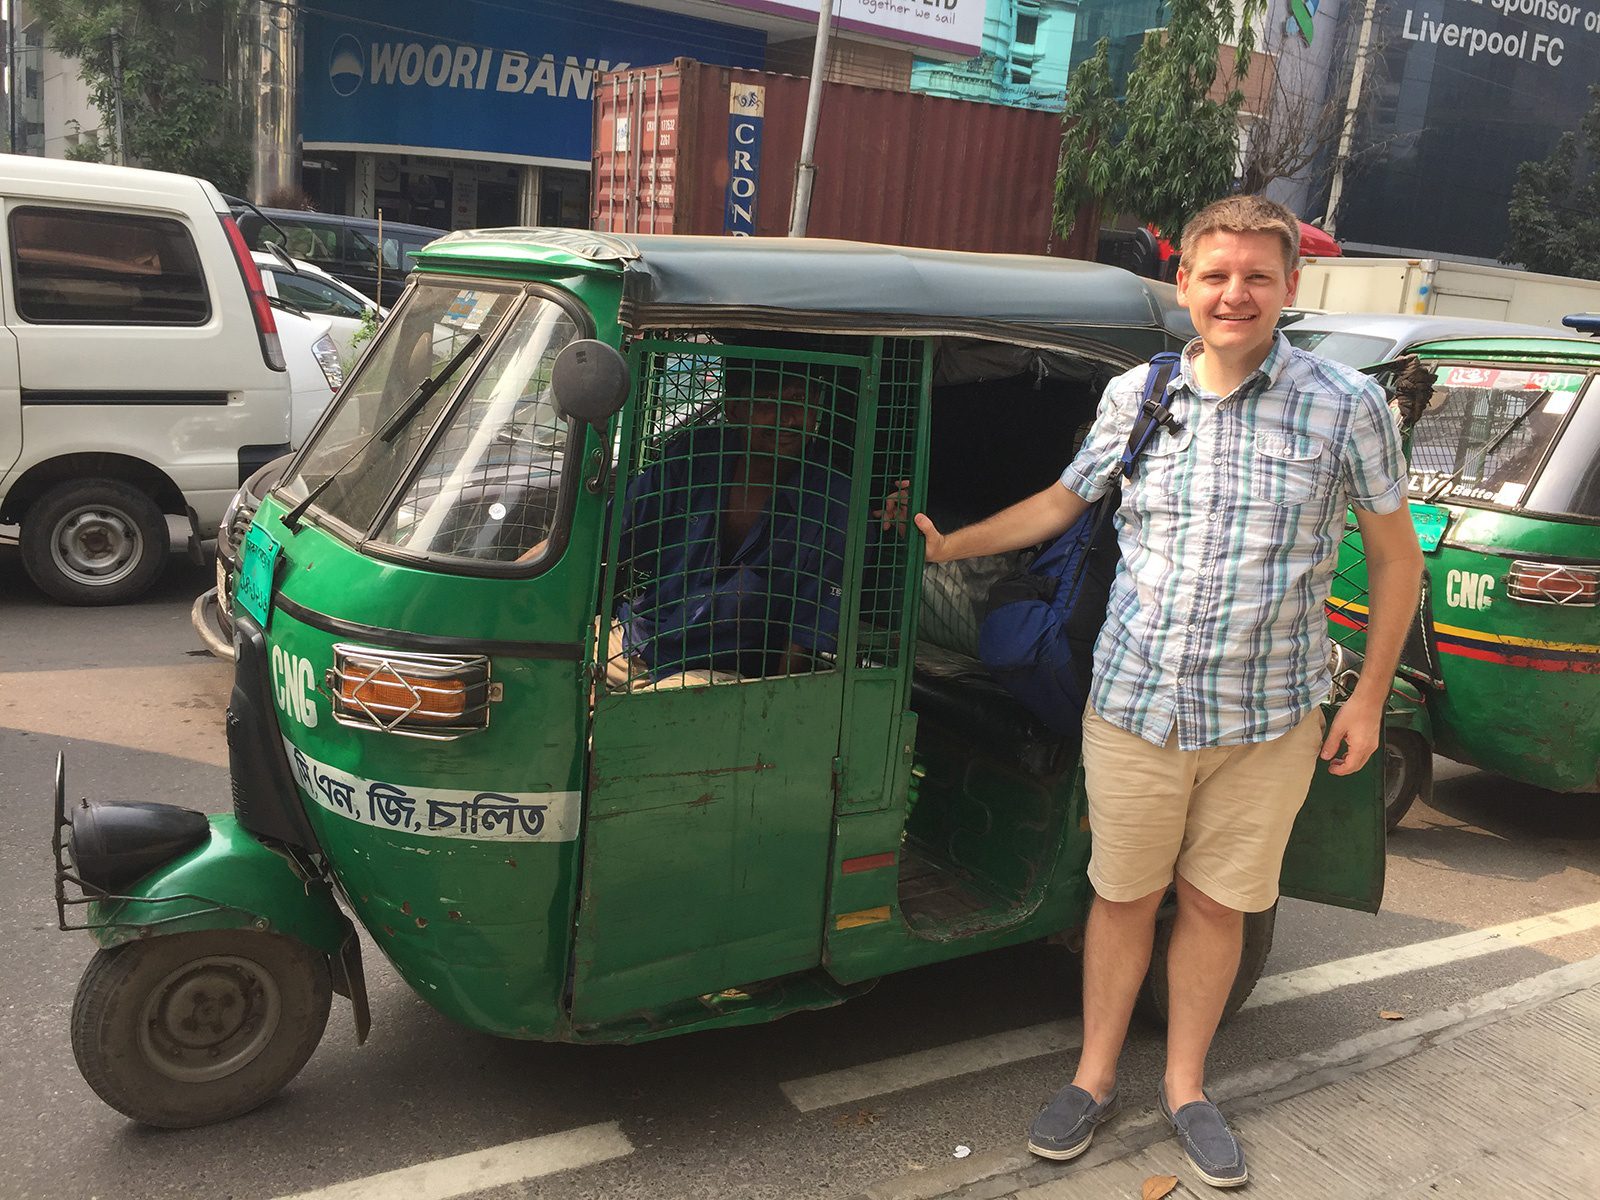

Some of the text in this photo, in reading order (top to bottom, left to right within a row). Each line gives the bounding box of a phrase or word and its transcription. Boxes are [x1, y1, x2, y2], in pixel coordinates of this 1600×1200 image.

[859, 0, 956, 25] ogether we sail
[1402, 9, 1565, 67] Liverpool FC
[370, 42, 493, 91] WOORI
[732, 123, 756, 237] CRON
[1407, 475, 1454, 497] LVO
[1446, 569, 1495, 612] CNG
[272, 644, 318, 729] CNG
